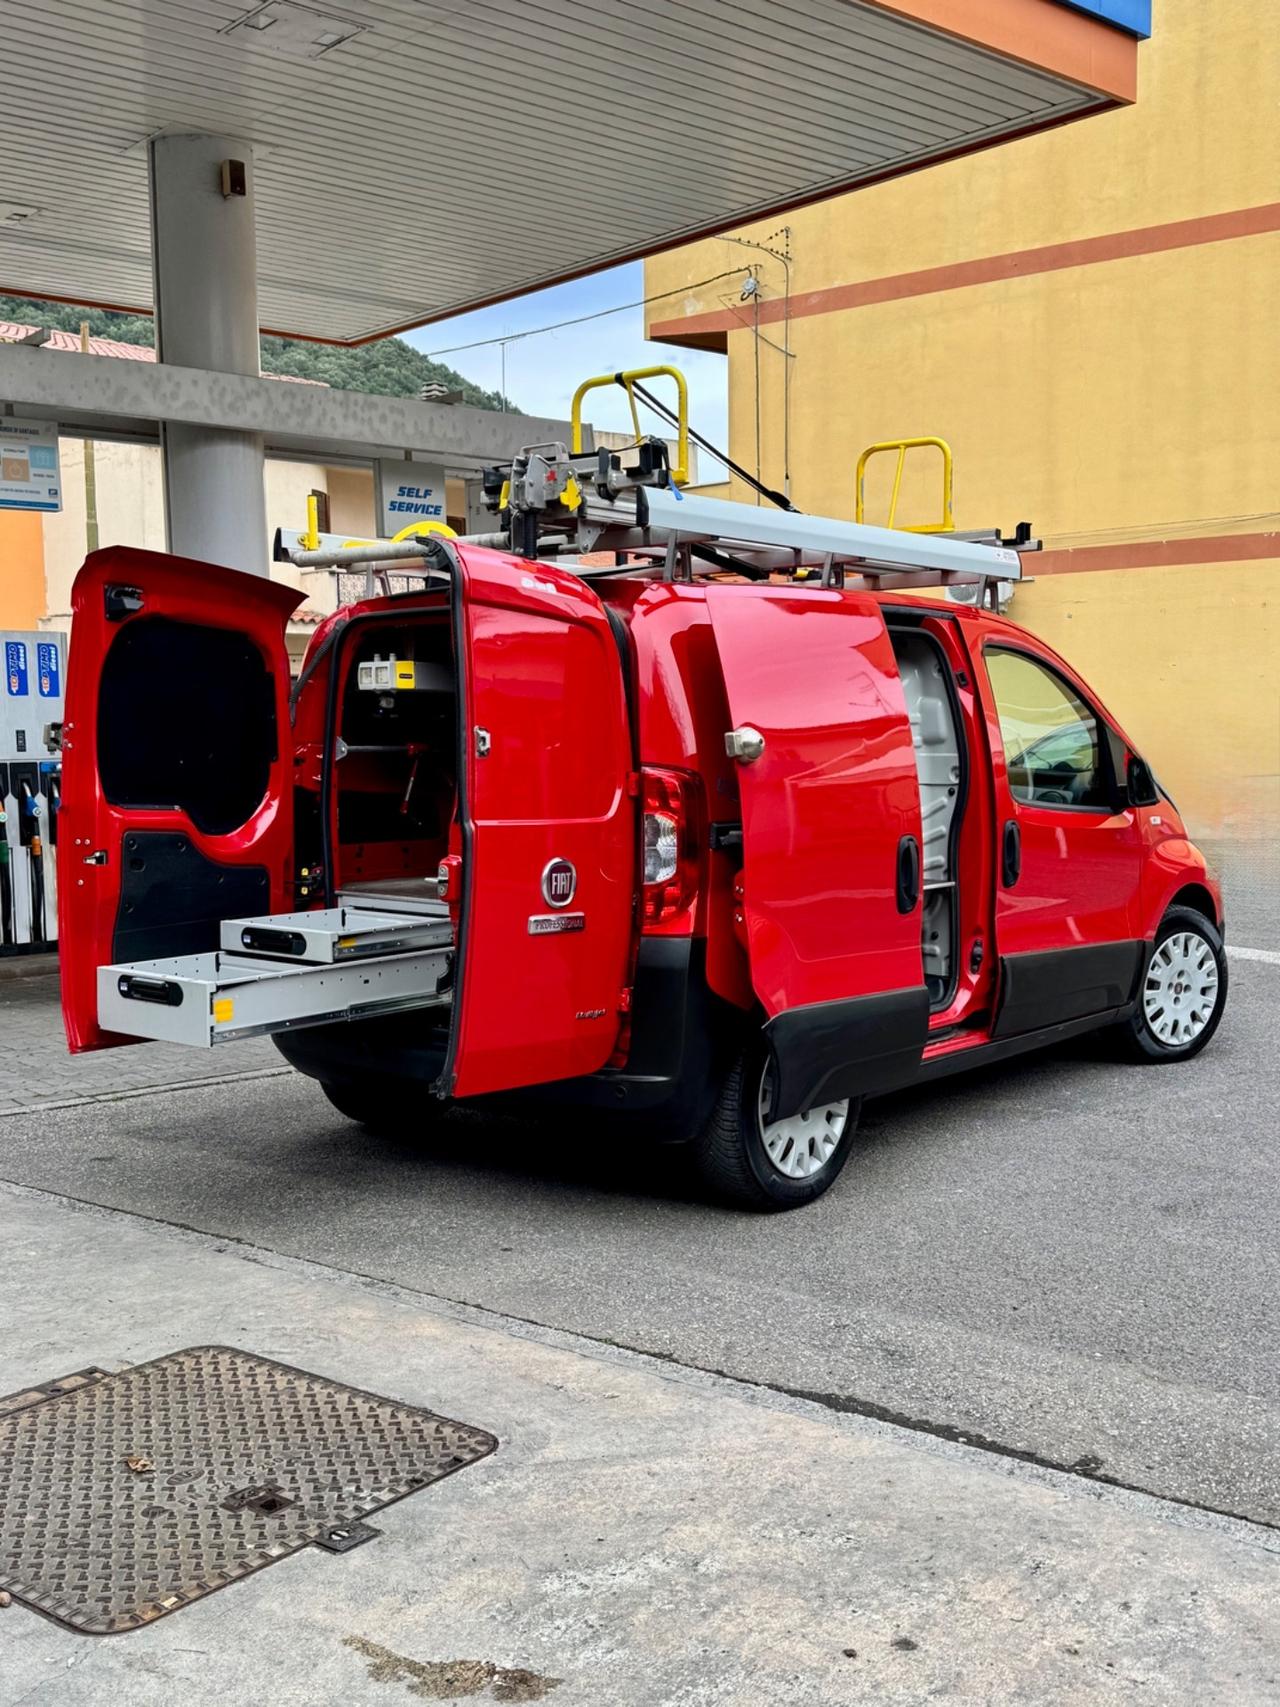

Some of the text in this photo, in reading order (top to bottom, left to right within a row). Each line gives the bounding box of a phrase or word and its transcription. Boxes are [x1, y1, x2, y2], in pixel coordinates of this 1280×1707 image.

[397, 486, 432, 499] SELF
[388, 500, 442, 516] SERVICE
[551, 872, 571, 895] FIAT
